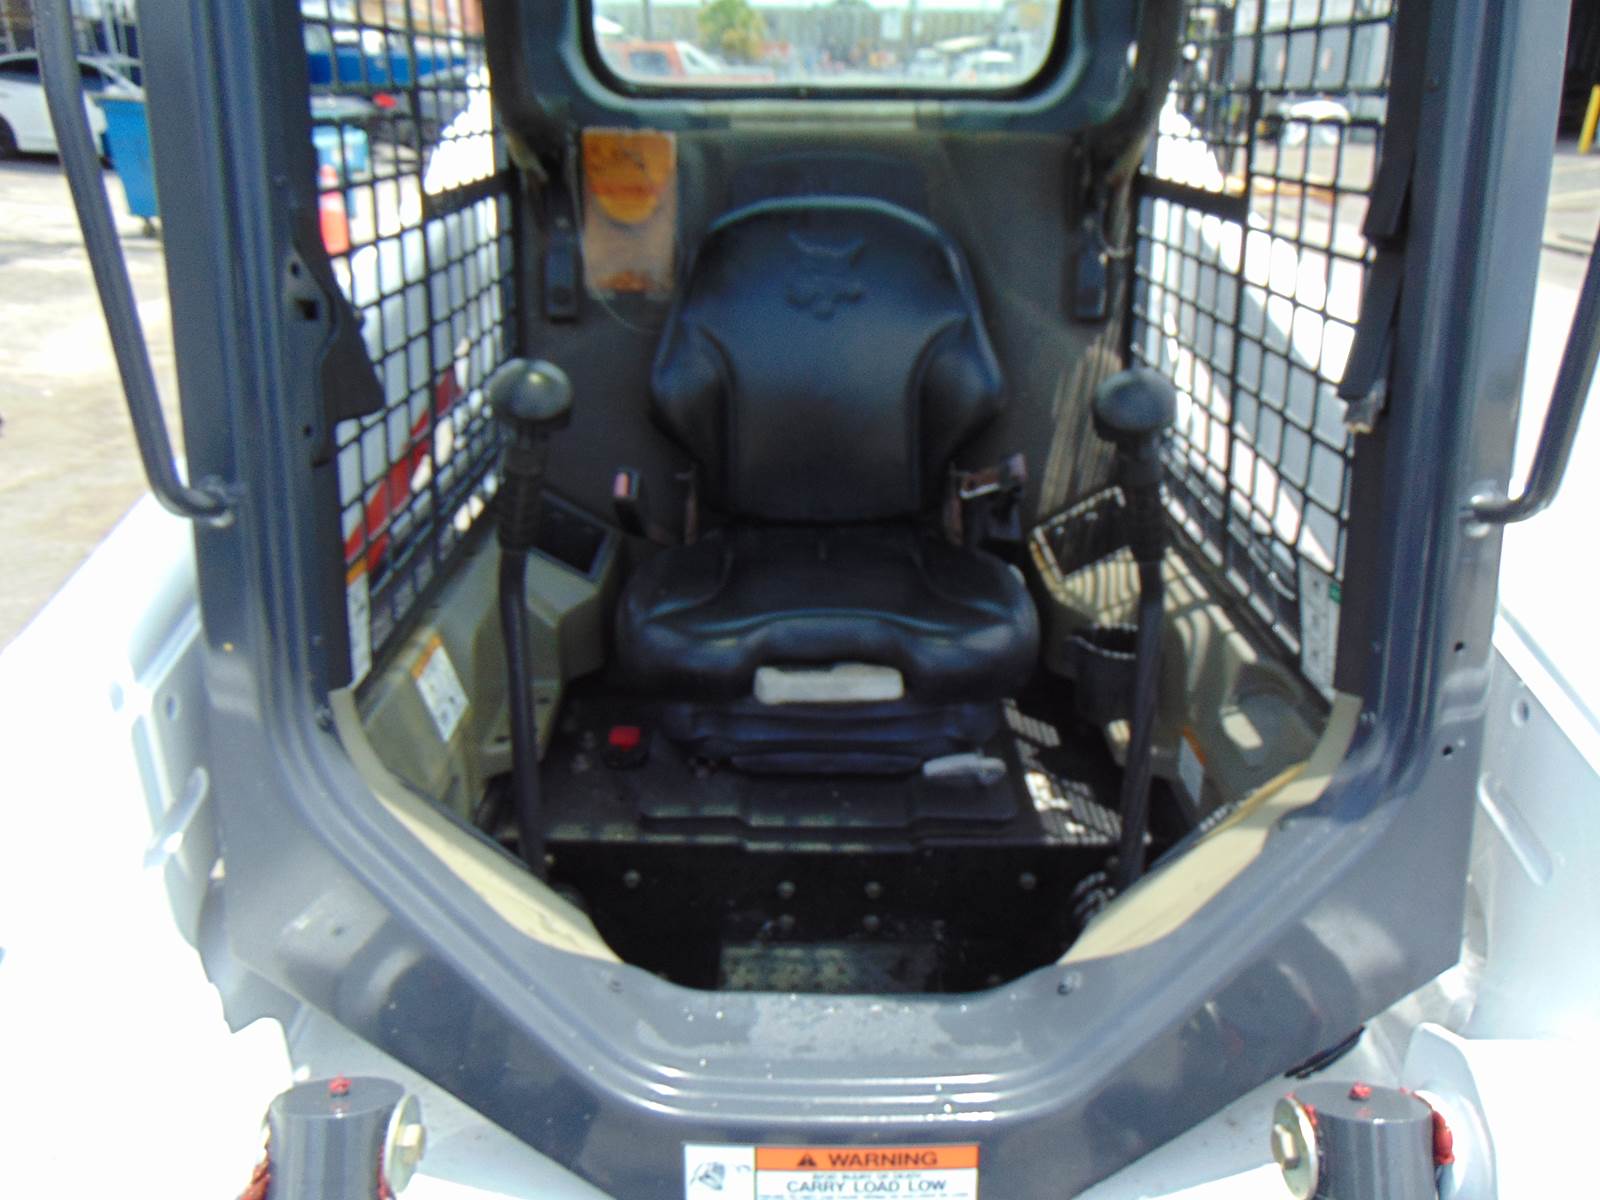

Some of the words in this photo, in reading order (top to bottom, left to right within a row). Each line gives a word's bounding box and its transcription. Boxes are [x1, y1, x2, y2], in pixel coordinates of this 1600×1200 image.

[828, 1151, 938, 1167] WARNING
[786, 1180, 845, 1193] CARRY
[853, 1180, 900, 1192] LOAD
[908, 1179, 947, 1192] LOW
